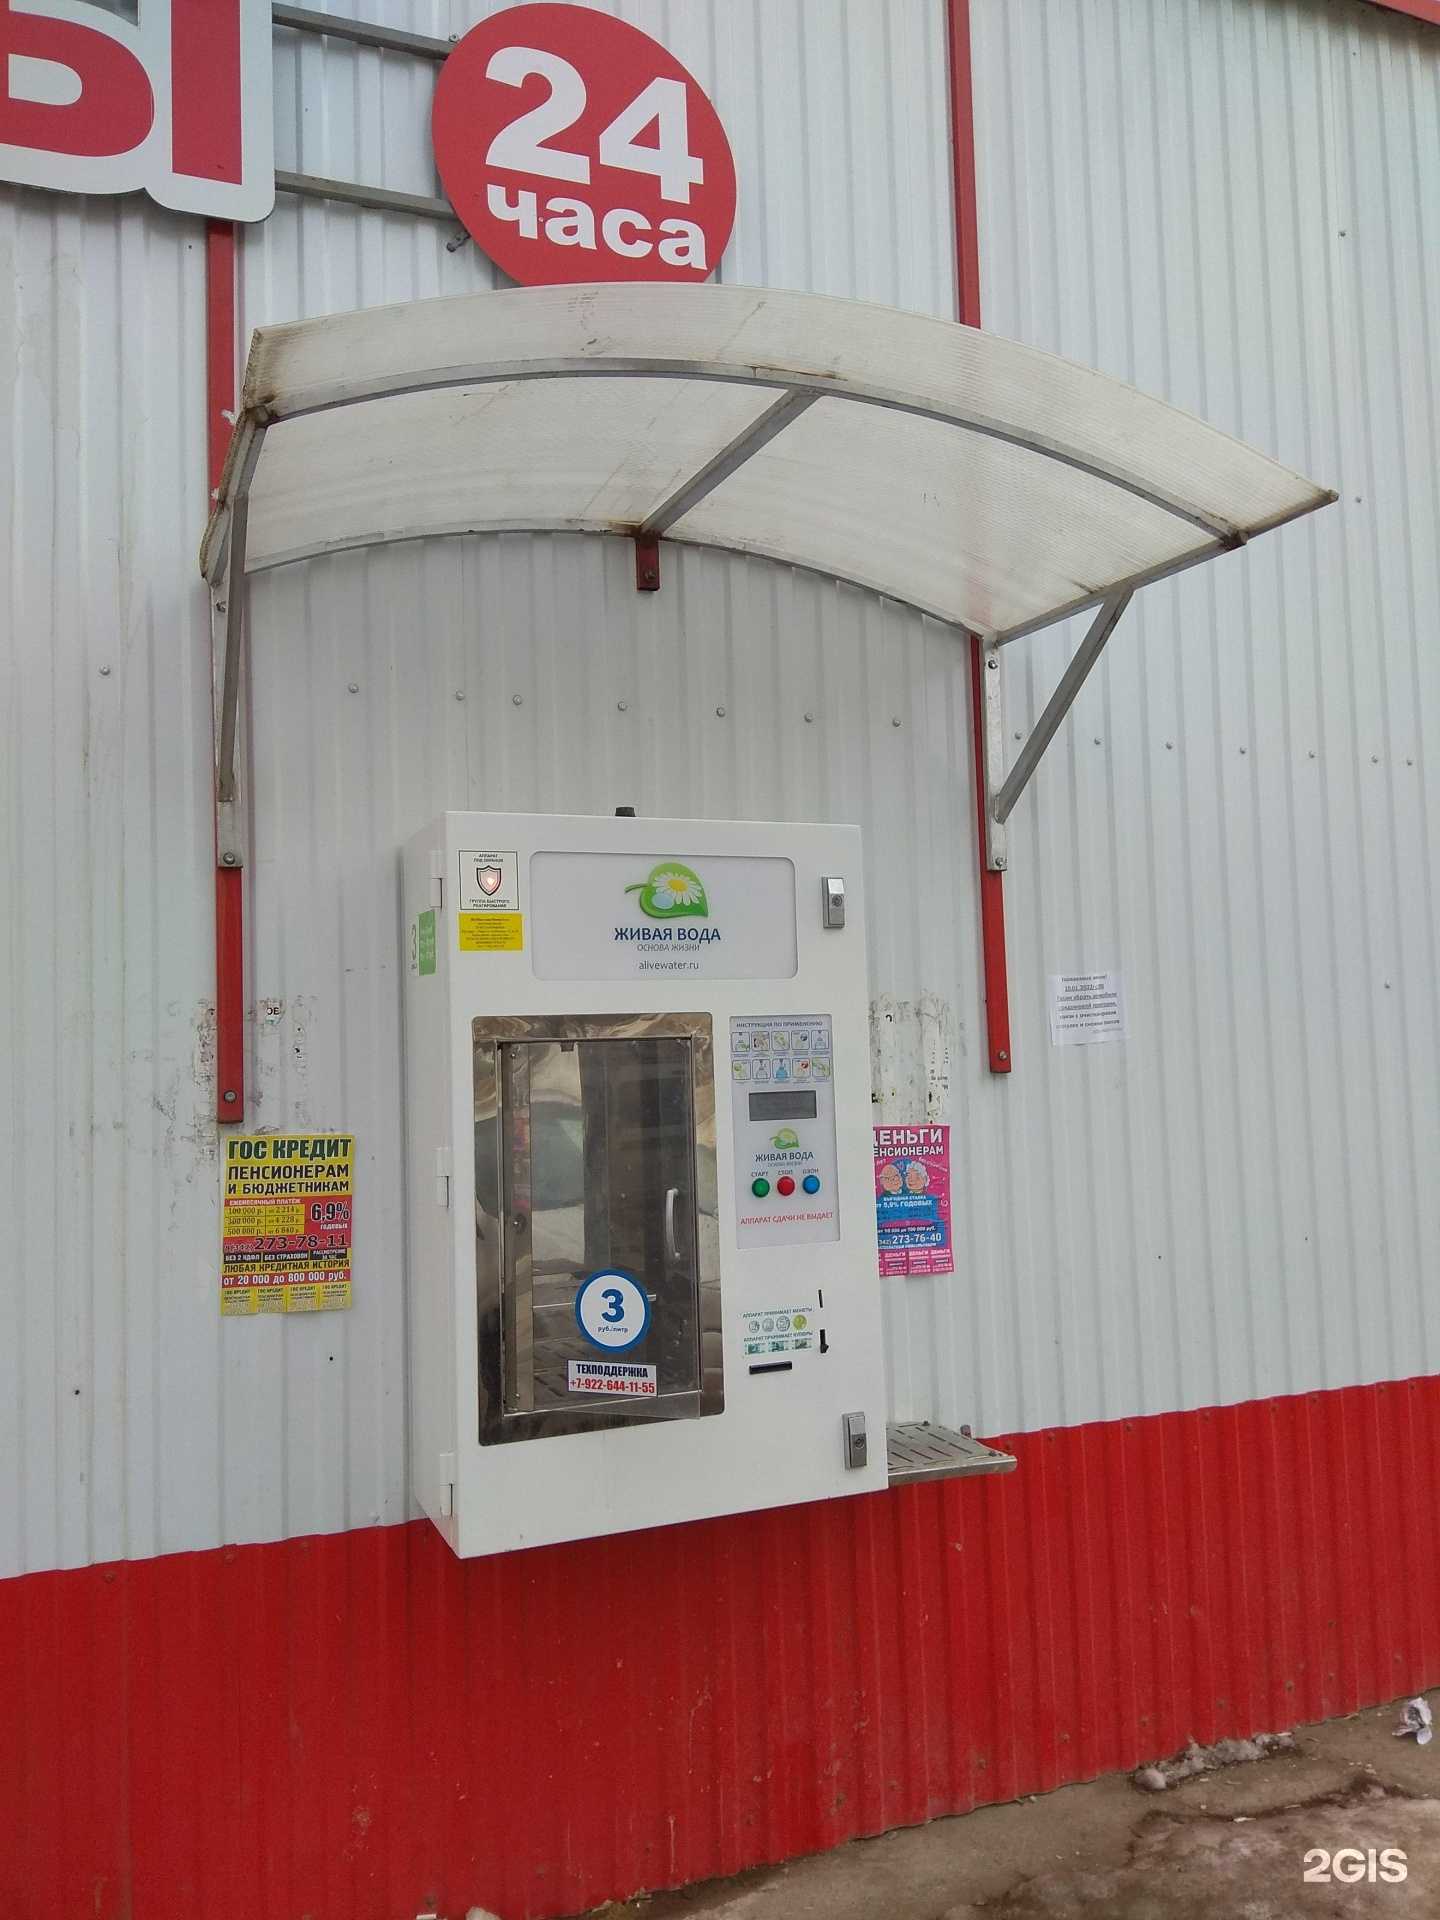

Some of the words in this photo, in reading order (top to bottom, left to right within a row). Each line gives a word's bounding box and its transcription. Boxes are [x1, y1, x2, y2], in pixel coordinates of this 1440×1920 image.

[486, 46, 704, 204] 24
[486, 185, 708, 270] часа
[614, 927, 672, 941] ЖИВАЯ
[677, 927, 721, 944] ВОДА
[637, 943, 669, 952] ОСНОВА
[671, 943, 700, 952] ЖИЗНИ
[638, 960, 699, 970] alivewater.ru
[228, 1140, 268, 1160] ГОС
[272, 1138, 352, 1160] КРЕДИТ
[756, 1152, 788, 1162] ЖИВАЯ
[790, 1152, 814, 1160] ВОДА
[228, 1164, 349, 1180] ПЕНСИОНЕРАМ
[228, 1184, 236, 1194] И
[242, 1181, 349, 1196] БЮДЖЕТНИКАМ
[740, 1216, 770, 1224] АППАРАТ
[254, 1233, 347, 1250] 273-78-11
[892, 1232, 942, 1244] 273-76-40
[224, 1264, 256, 1273] ЛЮБАЯ
[260, 1262, 310, 1272] КРЕДИТНАЯ
[312, 1259, 350, 1269] ИСТОРИЯ
[224, 1278, 234, 1286] от
[238, 1276, 248, 1284] 20
[252, 1274, 270, 1284] 000
[272, 1276, 284, 1284] до
[308, 1272, 325, 1281] 000
[328, 1272, 347, 1282] руб.
[601, 1288, 624, 1323] 3
[576, 1364, 648, 1378] ТЕХПОДДЕРЖКА
[570, 1378, 655, 1393] +7-922-644-11-55
